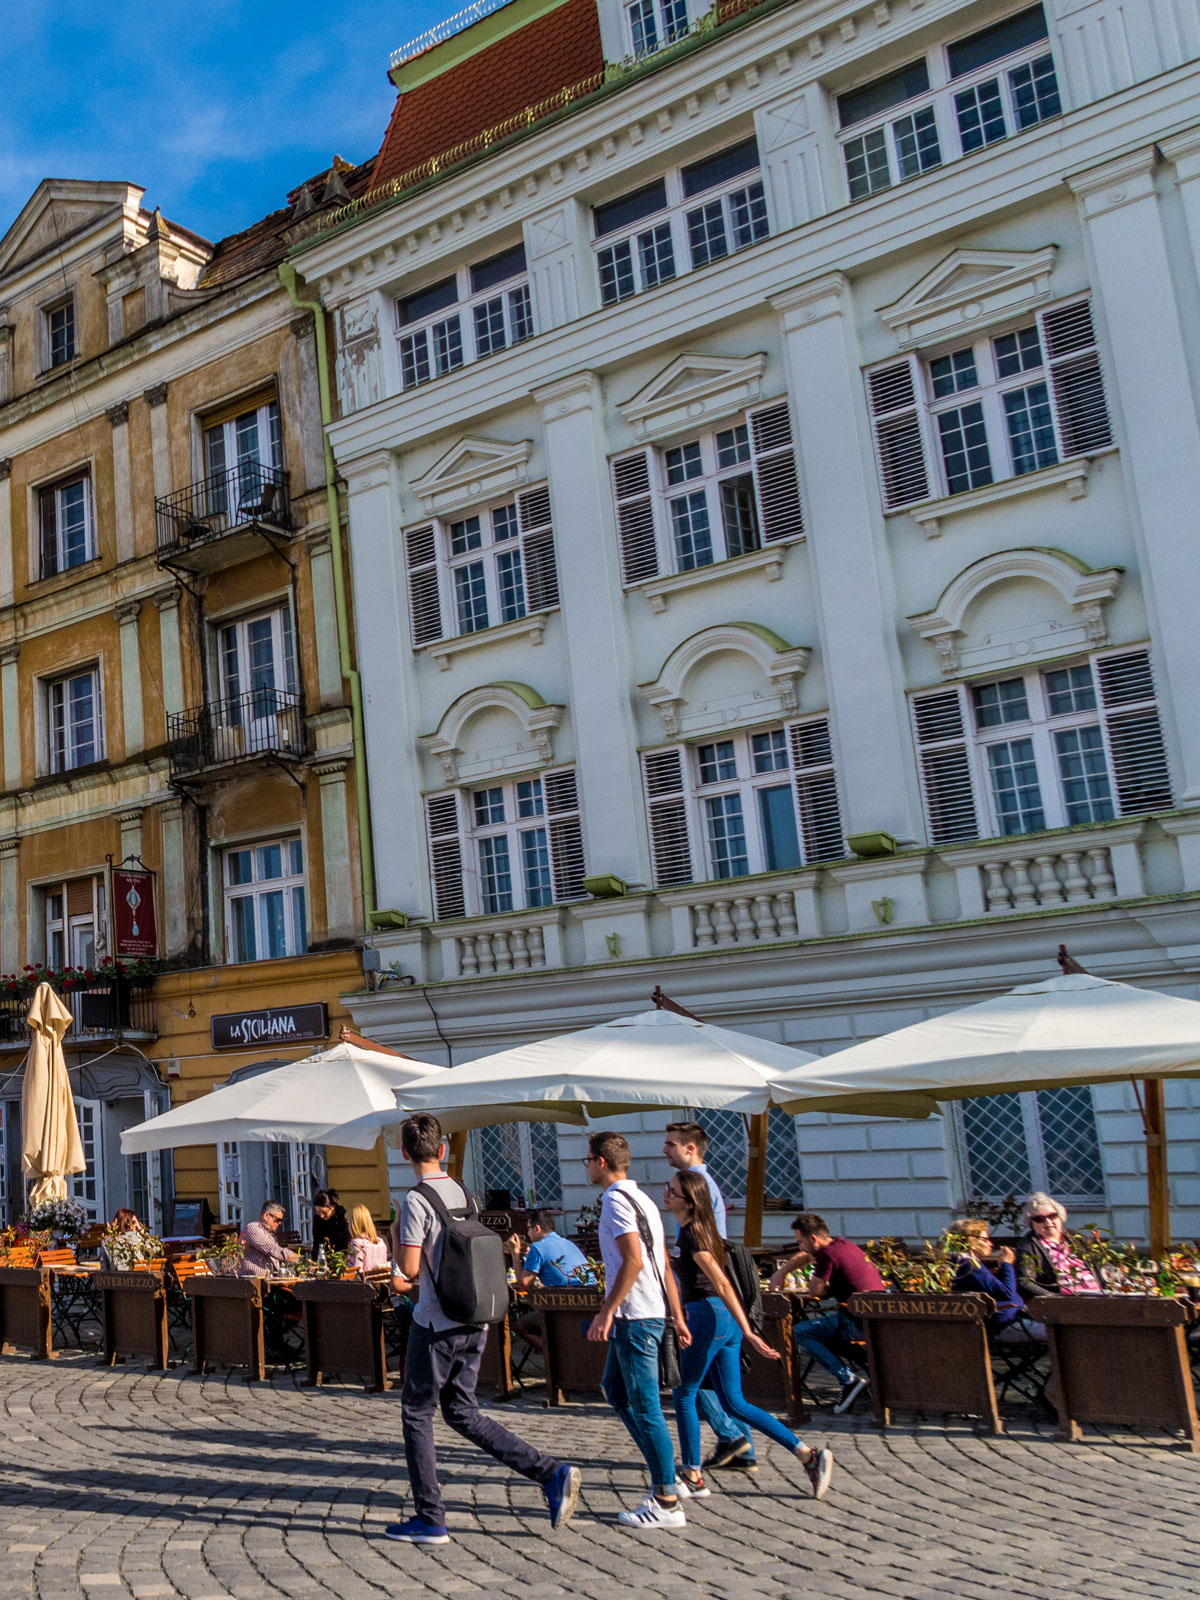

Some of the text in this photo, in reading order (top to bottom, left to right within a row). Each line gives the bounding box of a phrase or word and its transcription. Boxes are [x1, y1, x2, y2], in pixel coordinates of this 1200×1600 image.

[230, 1025, 241, 1038] LA
[96, 1276, 155, 1288] INTERMEZZO
[533, 1293, 605, 1306] INTERMEZ
[853, 1300, 979, 1317] INTERMEZZO
